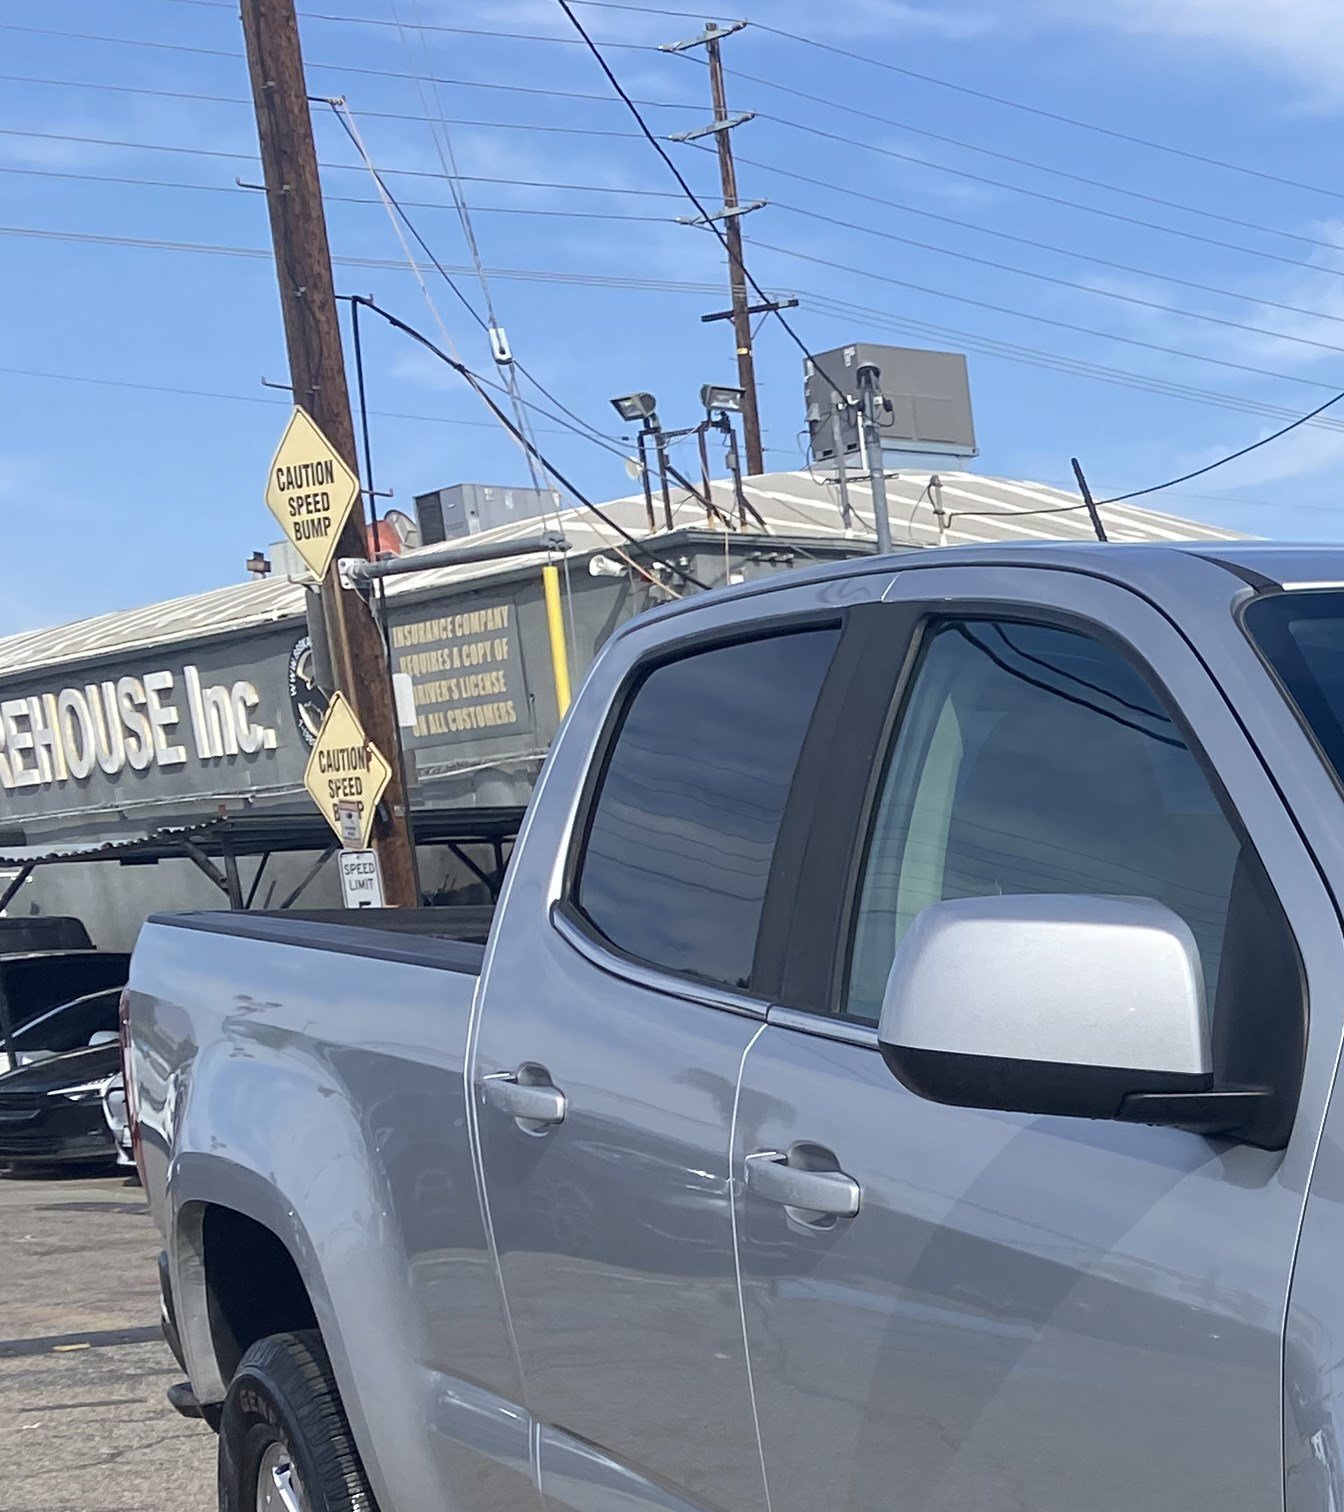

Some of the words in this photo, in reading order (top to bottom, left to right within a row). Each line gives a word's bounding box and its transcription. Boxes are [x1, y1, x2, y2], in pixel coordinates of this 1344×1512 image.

[276, 460, 335, 492] CAUTION
[288, 492, 330, 517] SPEED
[293, 516, 331, 541] BUMP
[392, 616, 453, 648] INSURANCE
[455, 605, 509, 637] COMPANY
[400, 648, 451, 677] REQUIRES
[453, 647, 461, 668] A
[461, 640, 491, 667] COPY
[493, 637, 509, 661] OF
[460, 670, 507, 698] LICENSE
[183, 665, 277, 760] Inc.
[428, 712, 449, 734] ALL
[447, 700, 517, 732] CUSTOMERS
[318, 746, 366, 774] CAUTION
[328, 777, 363, 799] SPEED
[333, 801, 365, 823] BP
[344, 863, 376, 876] SPEED
[348, 879, 374, 892] LIMIT
